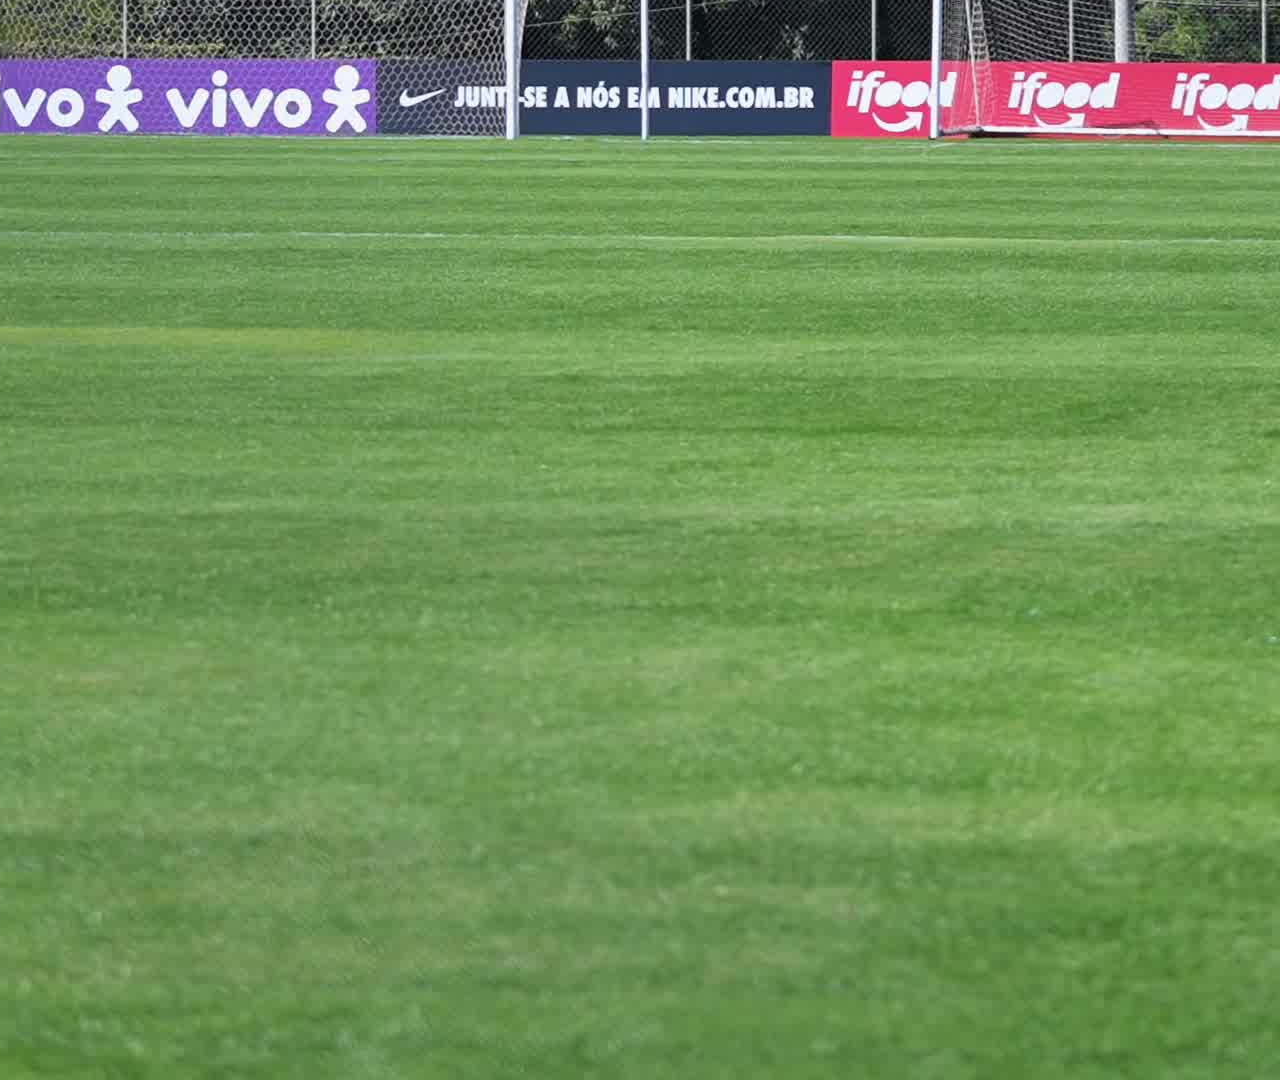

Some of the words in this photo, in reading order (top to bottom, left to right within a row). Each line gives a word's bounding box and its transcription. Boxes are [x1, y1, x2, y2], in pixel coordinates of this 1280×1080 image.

[166, 70, 312, 127] vivo
[454, 86, 548, 108] JUNT-SE
[554, 86, 570, 108] A
[577, 81, 620, 108] NÓS
[668, 86, 814, 108] NIKE.COM.BR
[1008, 72, 1120, 114] ifood
